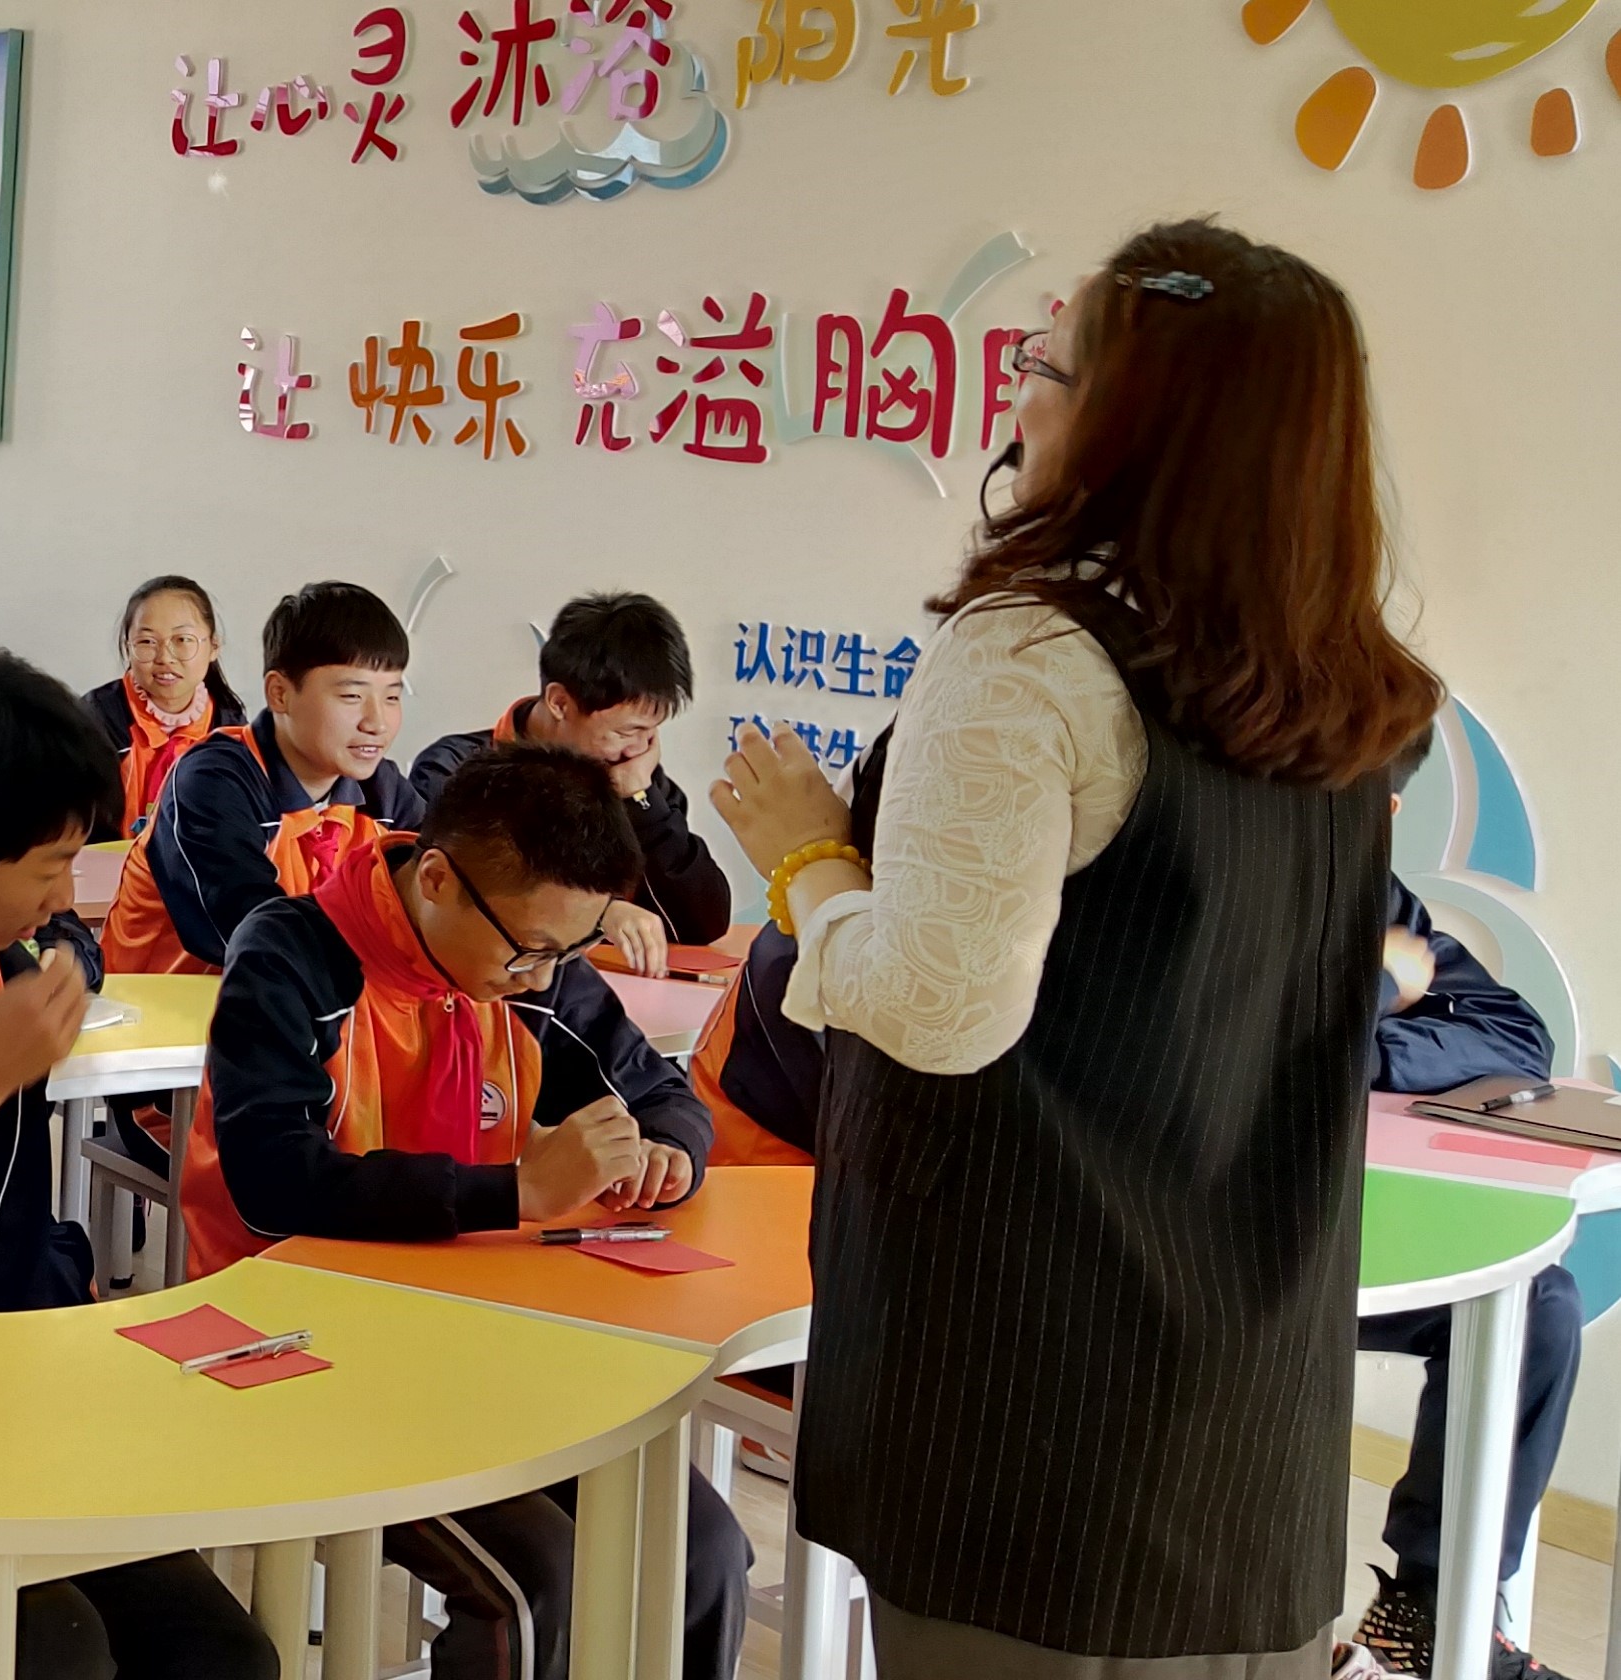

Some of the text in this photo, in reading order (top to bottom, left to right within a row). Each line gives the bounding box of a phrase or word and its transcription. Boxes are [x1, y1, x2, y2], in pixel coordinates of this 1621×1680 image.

[170, 0, 980, 166] 让心灵沐浴阳光
[733, 621, 922, 698] 认识生命
